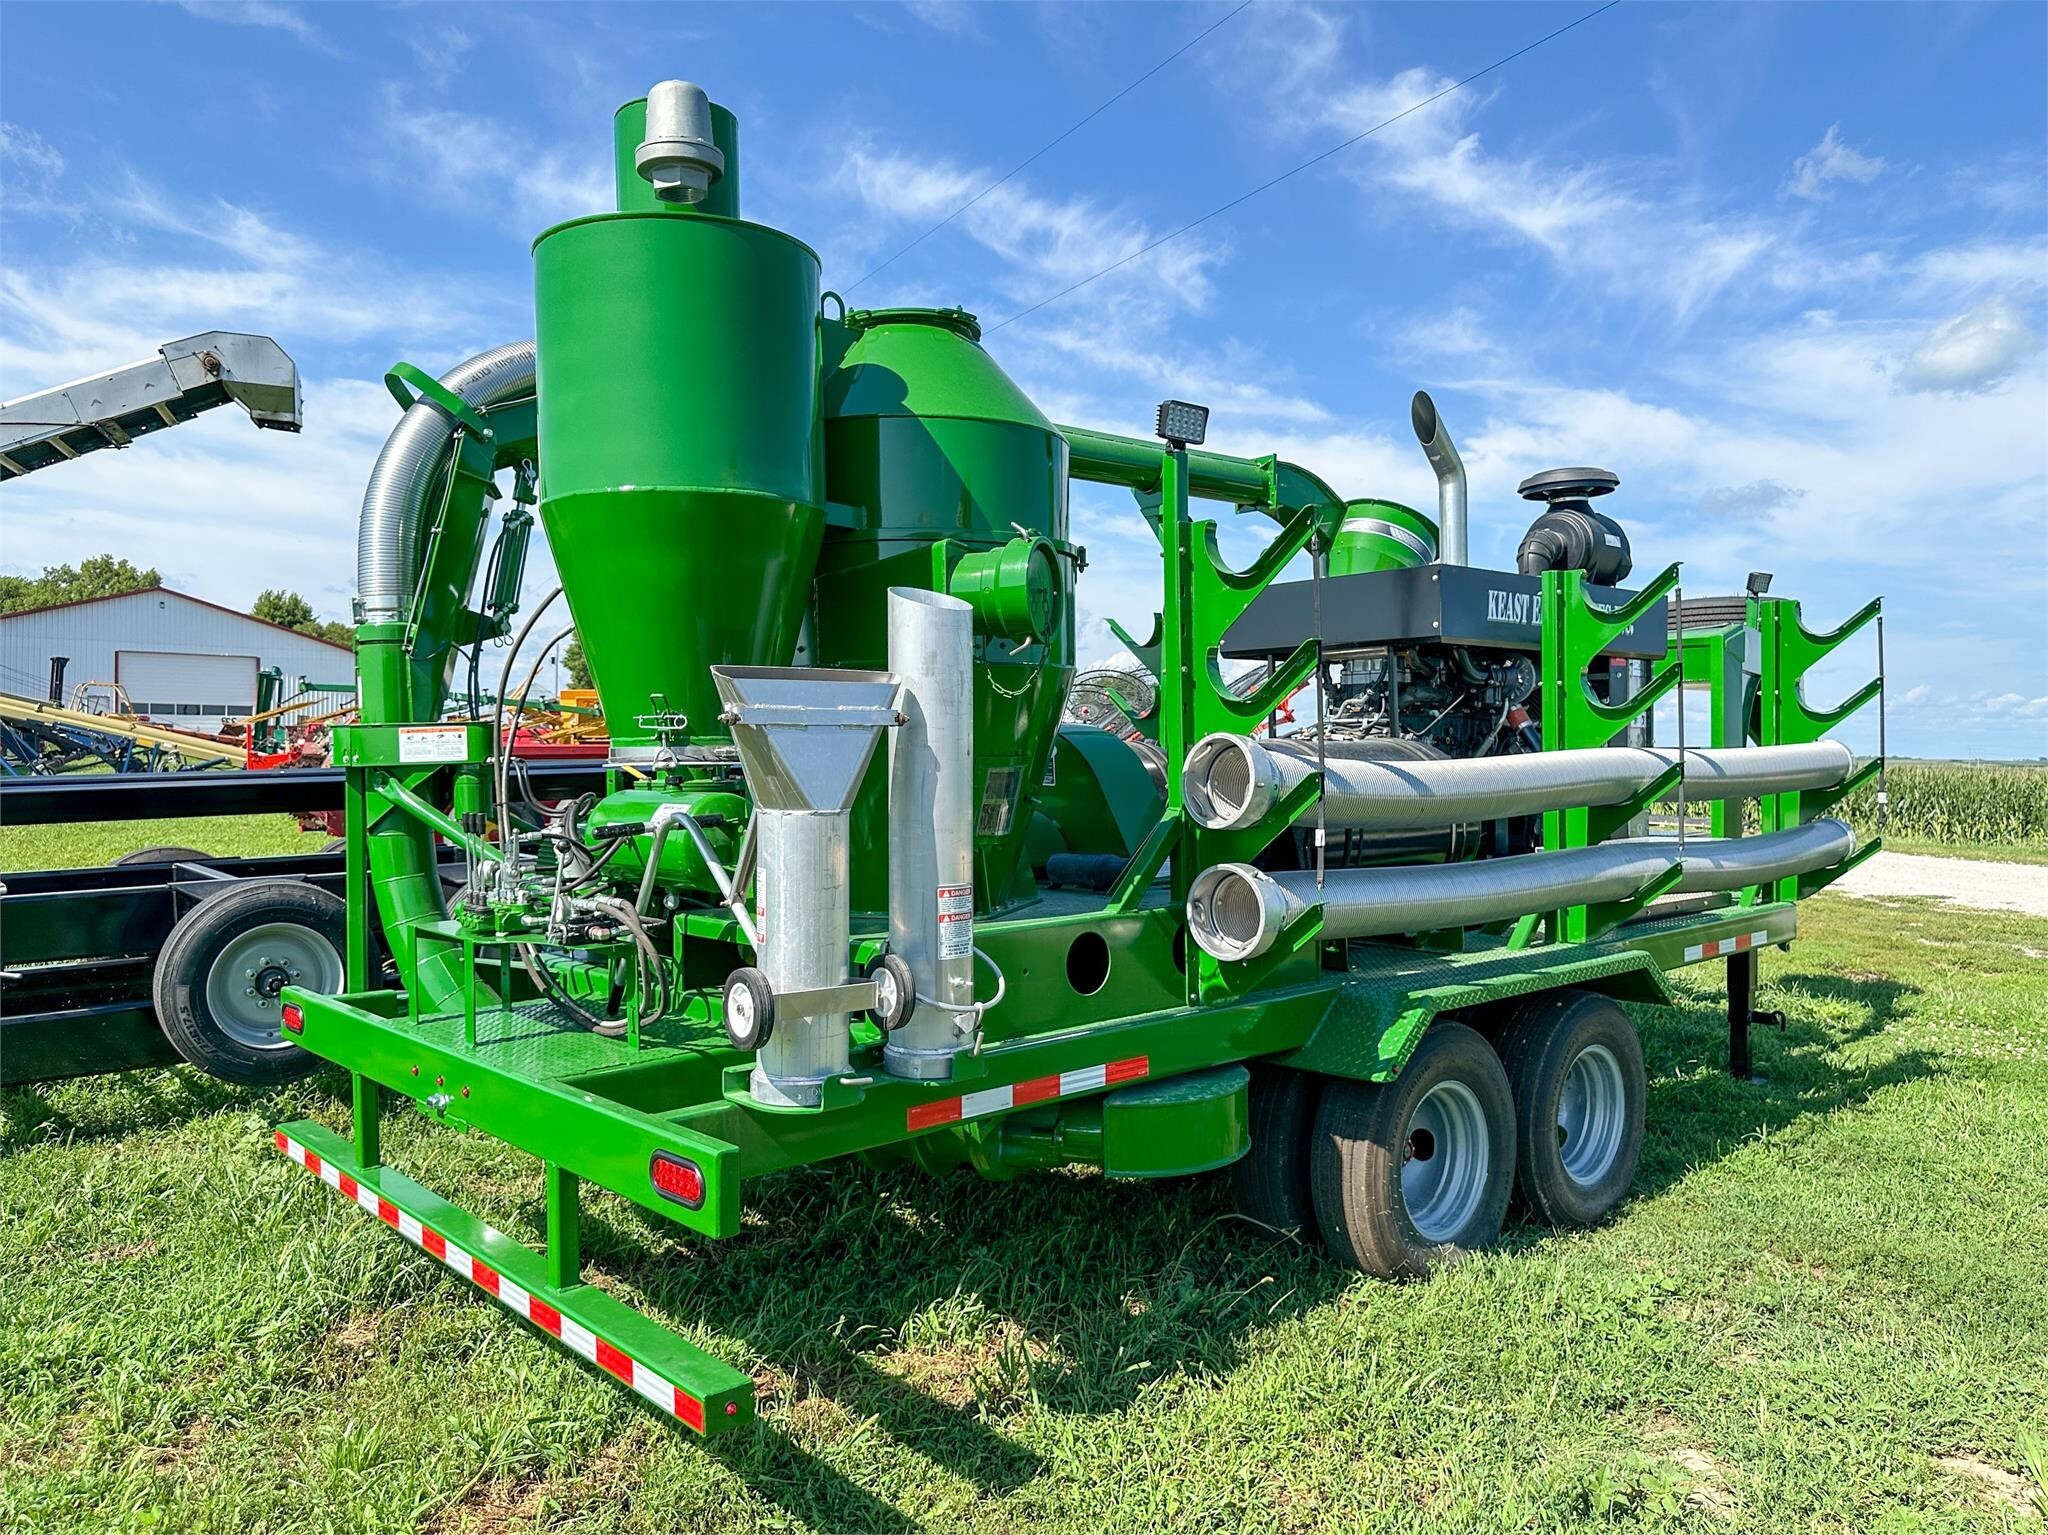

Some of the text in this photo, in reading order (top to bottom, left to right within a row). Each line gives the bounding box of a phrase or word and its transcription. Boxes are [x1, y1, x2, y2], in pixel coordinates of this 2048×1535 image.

[1487, 589, 1530, 624] KEAST
[950, 888, 971, 897] DANGER
[950, 914, 971, 922] DANGER
